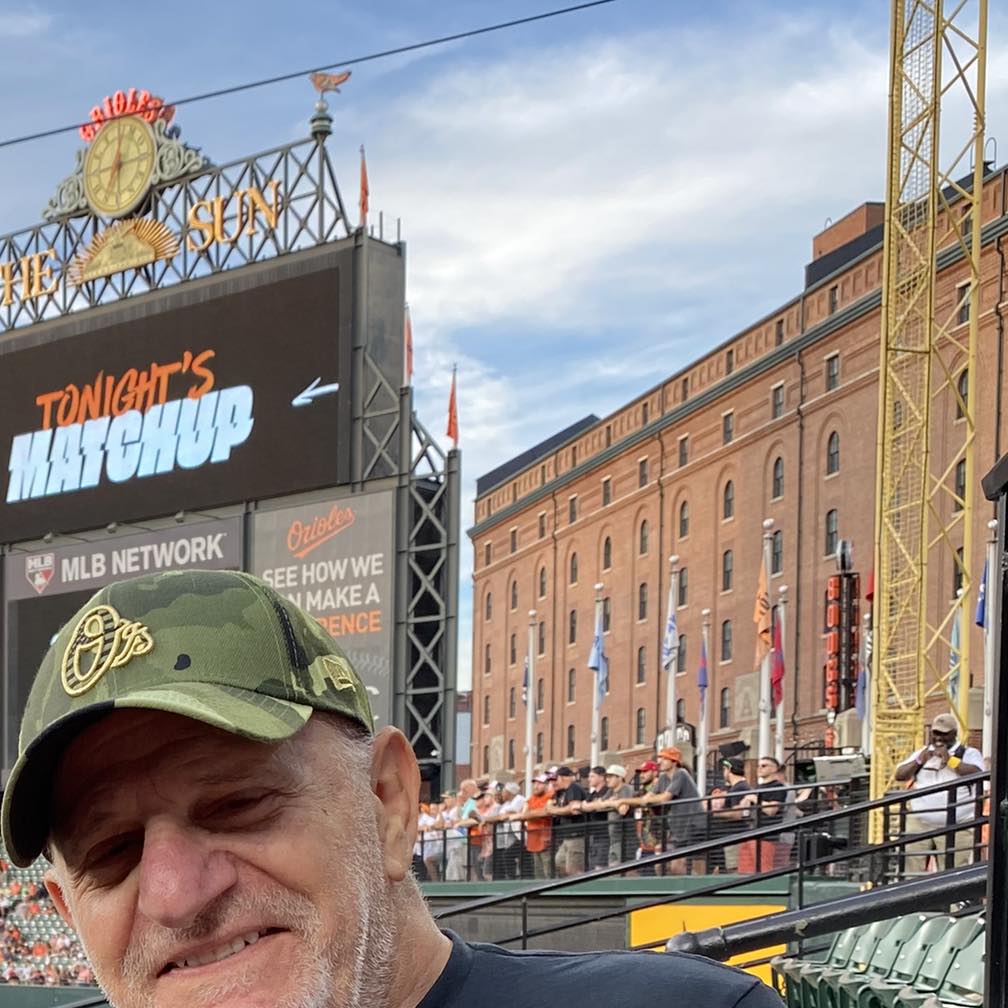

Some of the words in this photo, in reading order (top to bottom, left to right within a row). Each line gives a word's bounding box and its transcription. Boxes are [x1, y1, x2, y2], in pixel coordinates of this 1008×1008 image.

[186, 180, 281, 252] SUN
[36, 350, 216, 431] TONIGHT'S
[5, 384, 254, 503] MATCHUP
[286, 504, 356, 557] Orioles
[61, 552, 106, 583] MLB
[112, 533, 224, 575] NETWORK
[261, 565, 299, 589] SEE
[302, 557, 348, 586] HOW
[351, 553, 384, 578] WE
[306, 584, 363, 612] MAKE
[365, 582, 381, 604] A
